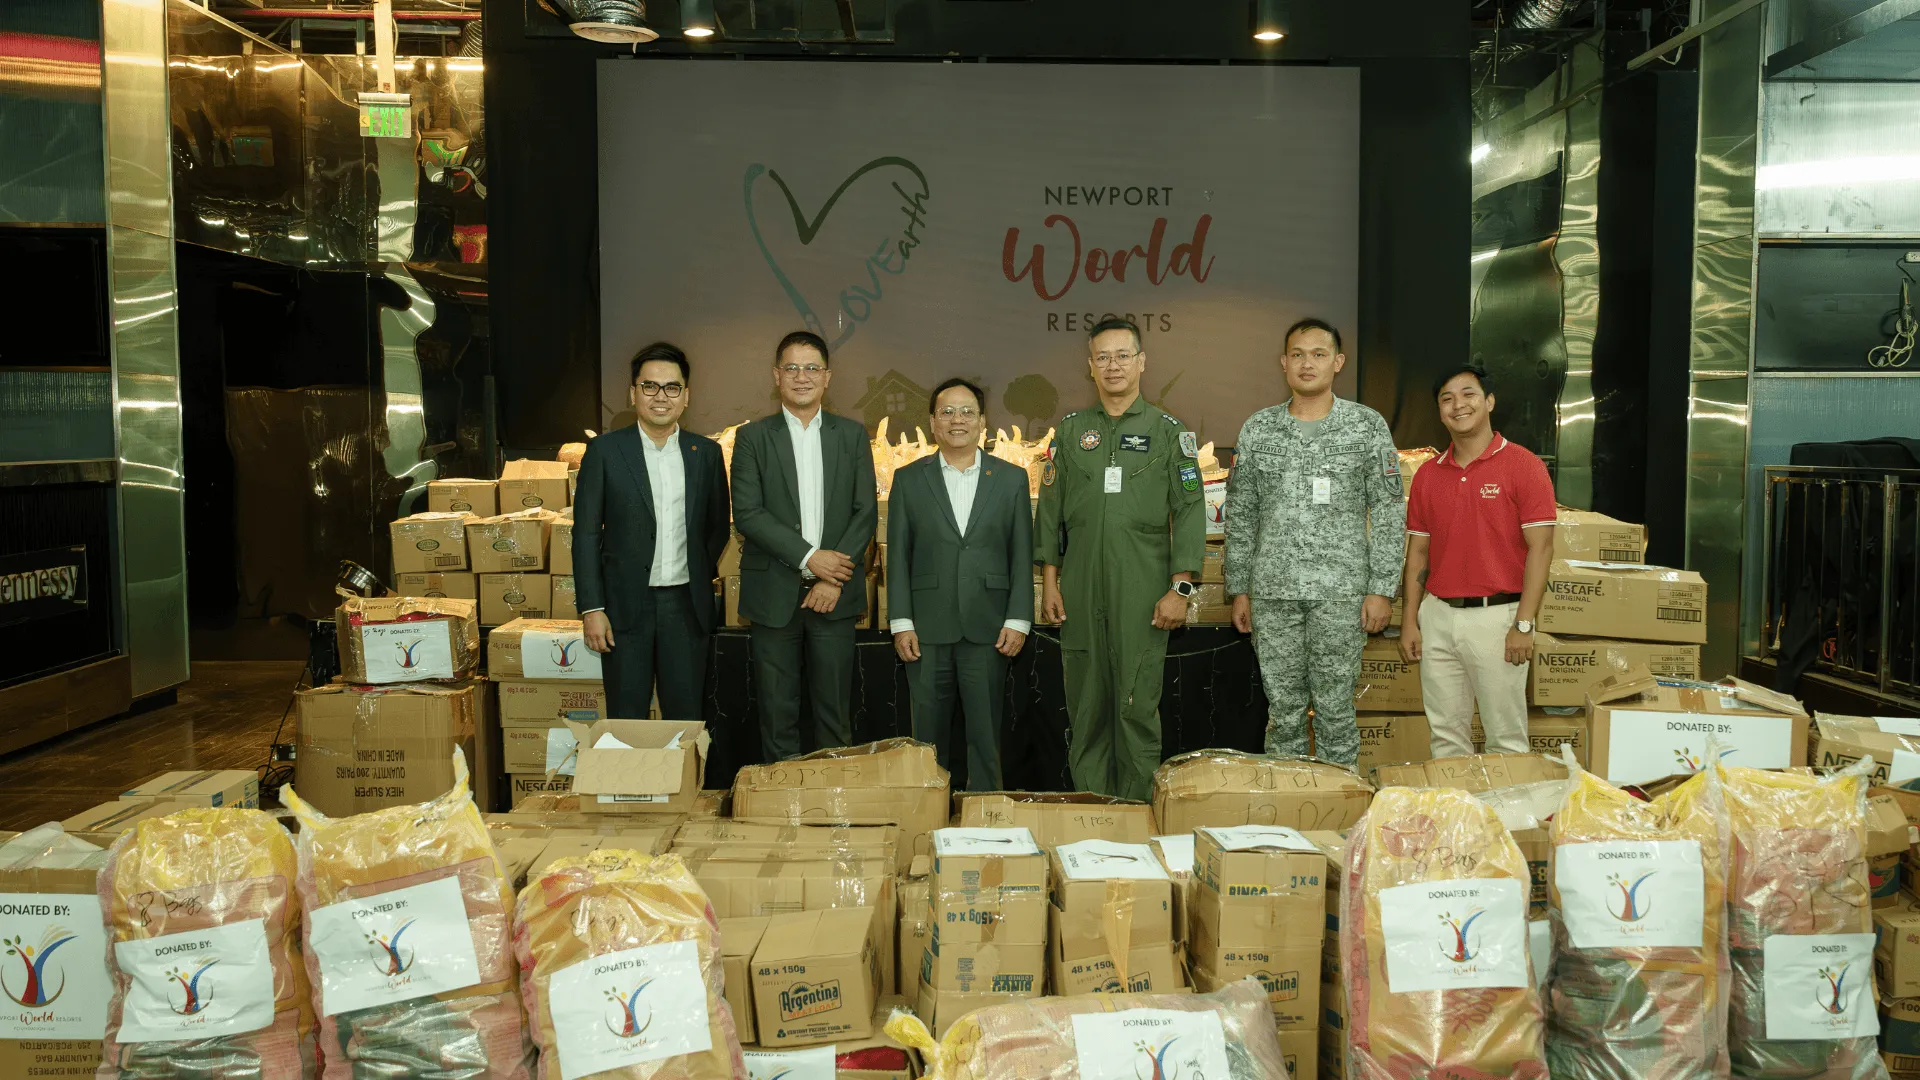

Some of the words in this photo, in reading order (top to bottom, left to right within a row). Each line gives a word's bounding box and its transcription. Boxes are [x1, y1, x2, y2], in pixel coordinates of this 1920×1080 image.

[368, 106, 406, 137] EXIT
[1044, 186, 1173, 206] NEWPORT
[1002, 213, 1215, 301] World
[0, 565, 78, 605] ennessy
[1555, 594, 1591, 603] ORIGINAL
[570, 692, 590, 700] CUP
[561, 699, 598, 708] NOODLES
[1360, 722, 1394, 739] CAFÉ
[1666, 720, 1715, 733] DONATED
[1718, 723, 1732, 734] BY:
[356, 750, 377, 761] CHINA
[379, 750, 385, 761] IN
[386, 749, 405, 761] MADE
[336, 766, 355, 779] PAIRS
[356, 767, 370, 778] 200
[371, 766, 406, 779] QUANTITY:
[354, 786, 384, 797] SLIPER
[385, 786, 405, 797] HIEX
[1598, 851, 1637, 860] DONATED
[1639, 851, 1652, 859] BY:
[1308, 875, 1319, 886] 48
[1428, 889, 1468, 899] DONATED
[54, 904, 70, 916] BY:
[352, 902, 394, 920] DONATED
[395, 899, 409, 910] BY:
[946, 911, 957, 923] 48
[155, 942, 197, 956] DONATED
[199, 939, 213, 949] BY:
[1811, 945, 1840, 953] DONATED
[1224, 953, 1235, 961] 48
[1247, 953, 1269, 963] 150g
[594, 961, 633, 976] DONATED
[758, 967, 771, 976] 48
[782, 964, 806, 974] 150g
[1071, 965, 1083, 974] 48
[781, 984, 839, 1013] Argentina
[20, 1011, 54, 1025] World
[1123, 1019, 1160, 1027] DONATED
[35, 1054, 53, 1063] BAG
[54, 1054, 93, 1063] LAUNDRY
[27, 1066, 65, 1076] EXPRESS
[67, 1066, 81, 1075] INN
